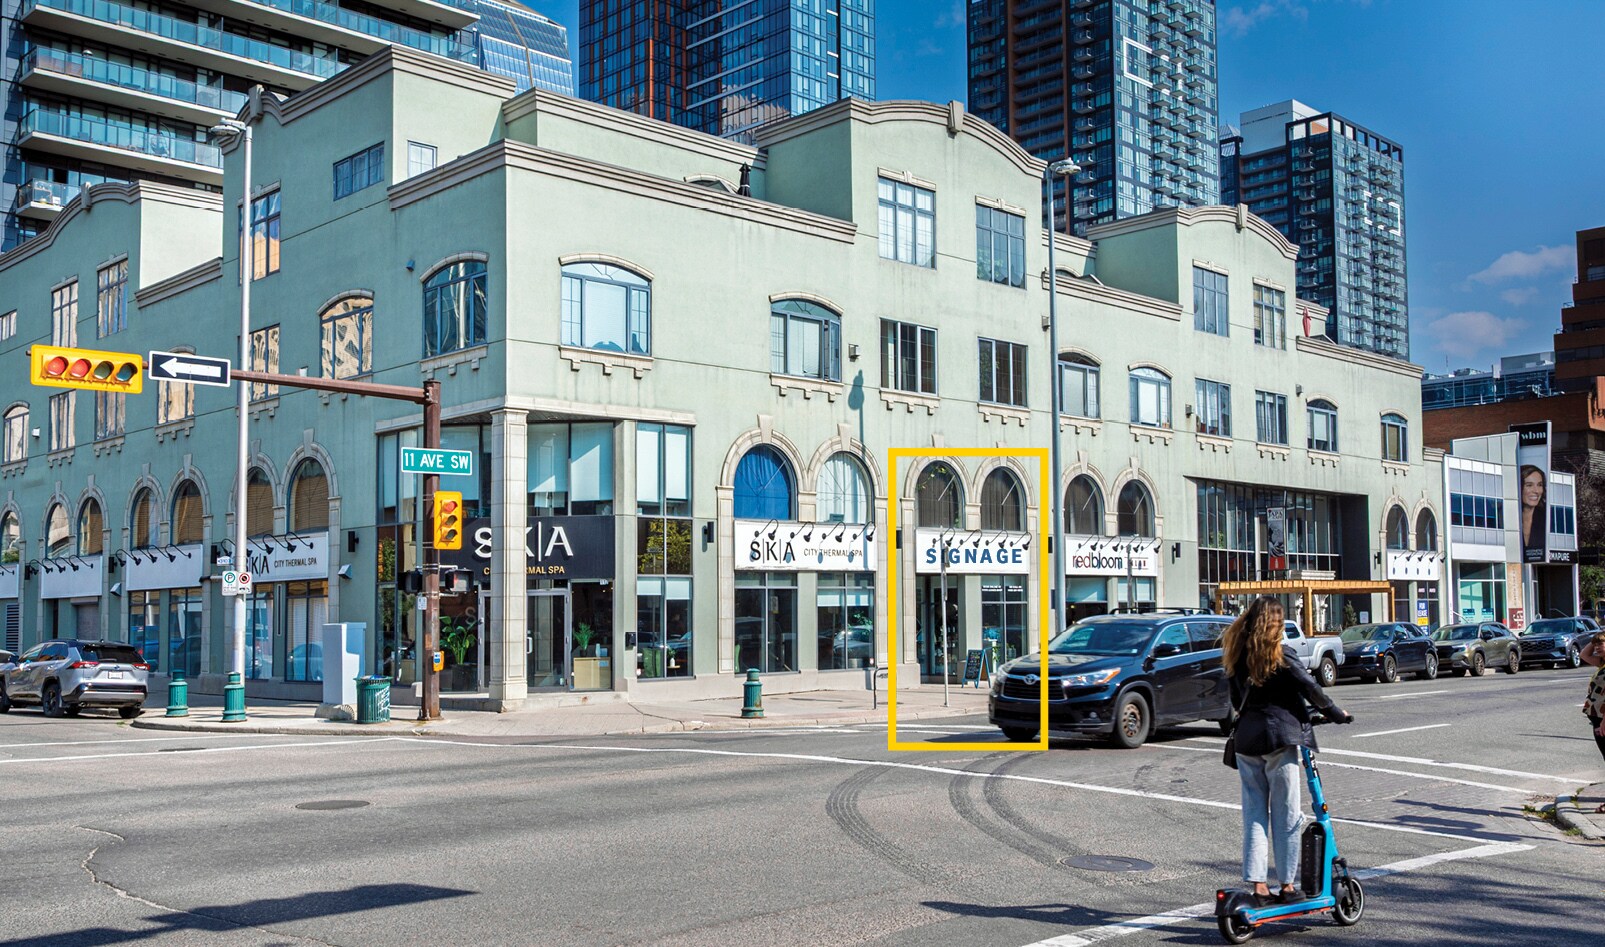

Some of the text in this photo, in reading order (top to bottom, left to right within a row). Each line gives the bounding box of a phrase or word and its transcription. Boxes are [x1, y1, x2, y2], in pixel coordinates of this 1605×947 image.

[404, 453, 469, 469] 11 AVE SW
[803, 548, 863, 557] CITY THERMAL SPA
[926, 548, 1023, 564] SIGNAGE
[274, 557, 317, 568] CITY THERMAL SPA
[1072, 552, 1123, 569] redbloom
[548, 566, 565, 574] SPA
